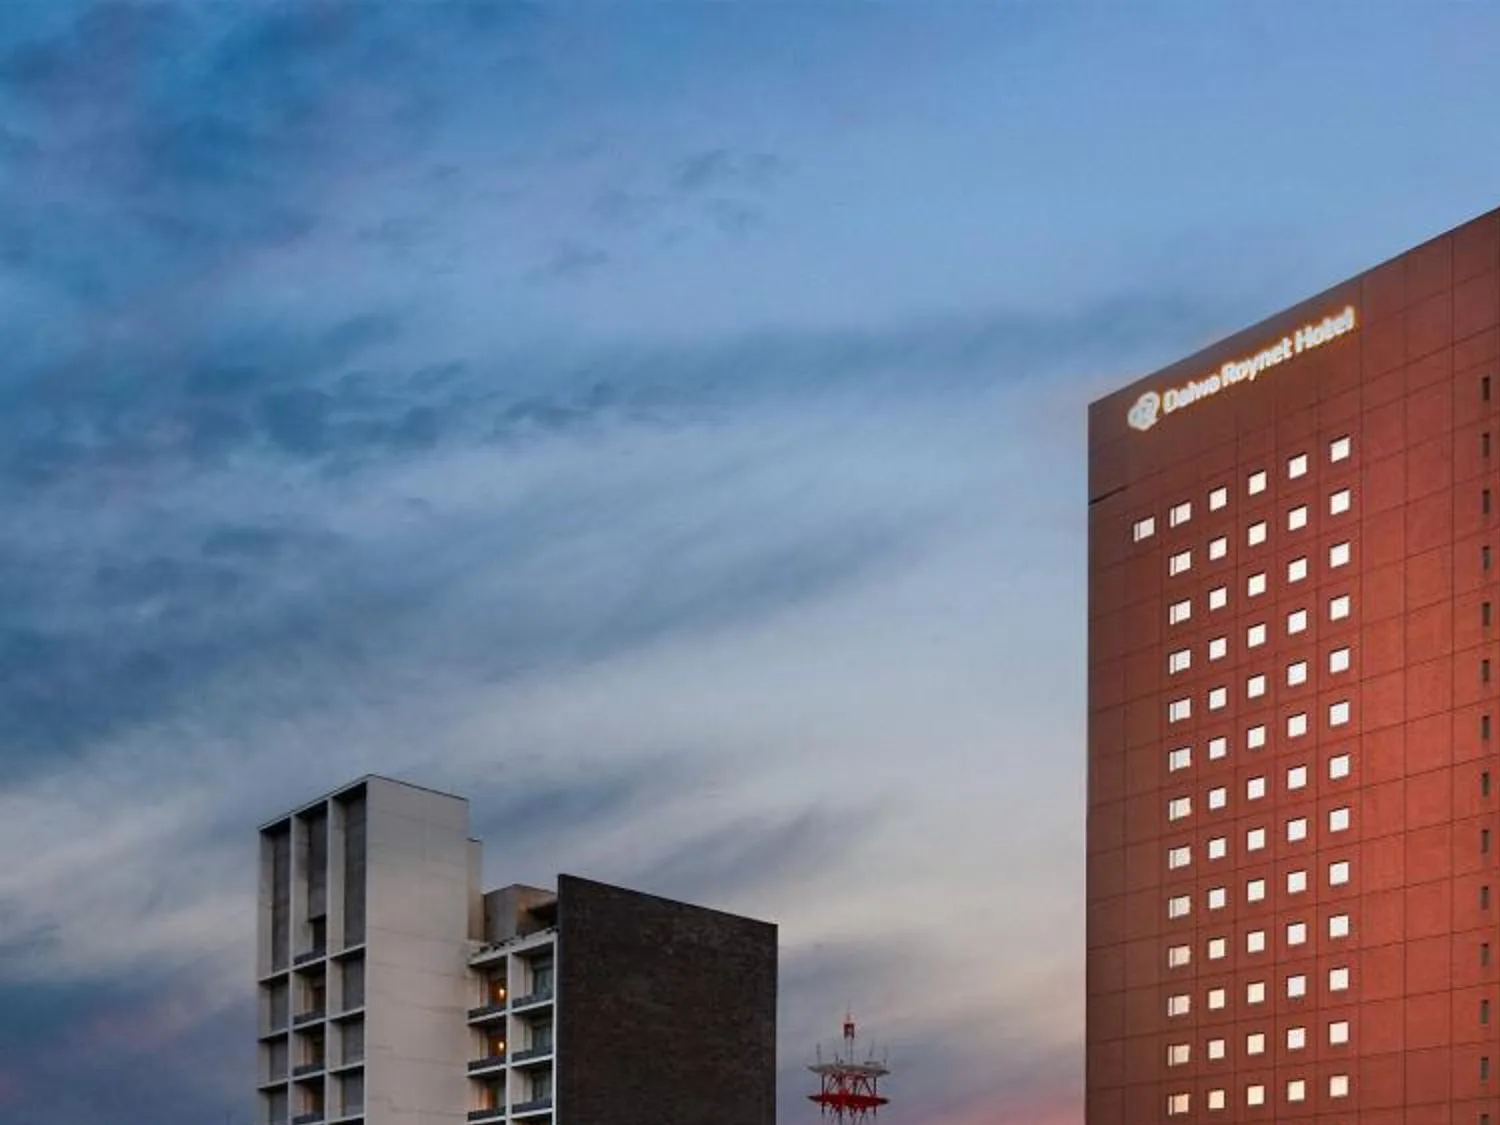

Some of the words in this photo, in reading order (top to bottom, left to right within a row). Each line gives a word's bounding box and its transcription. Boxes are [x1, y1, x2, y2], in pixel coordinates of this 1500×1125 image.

[1163, 374, 1221, 414] Daiwa
[1221, 336, 1293, 387] Roynet
[1294, 305, 1355, 353] Hotel
